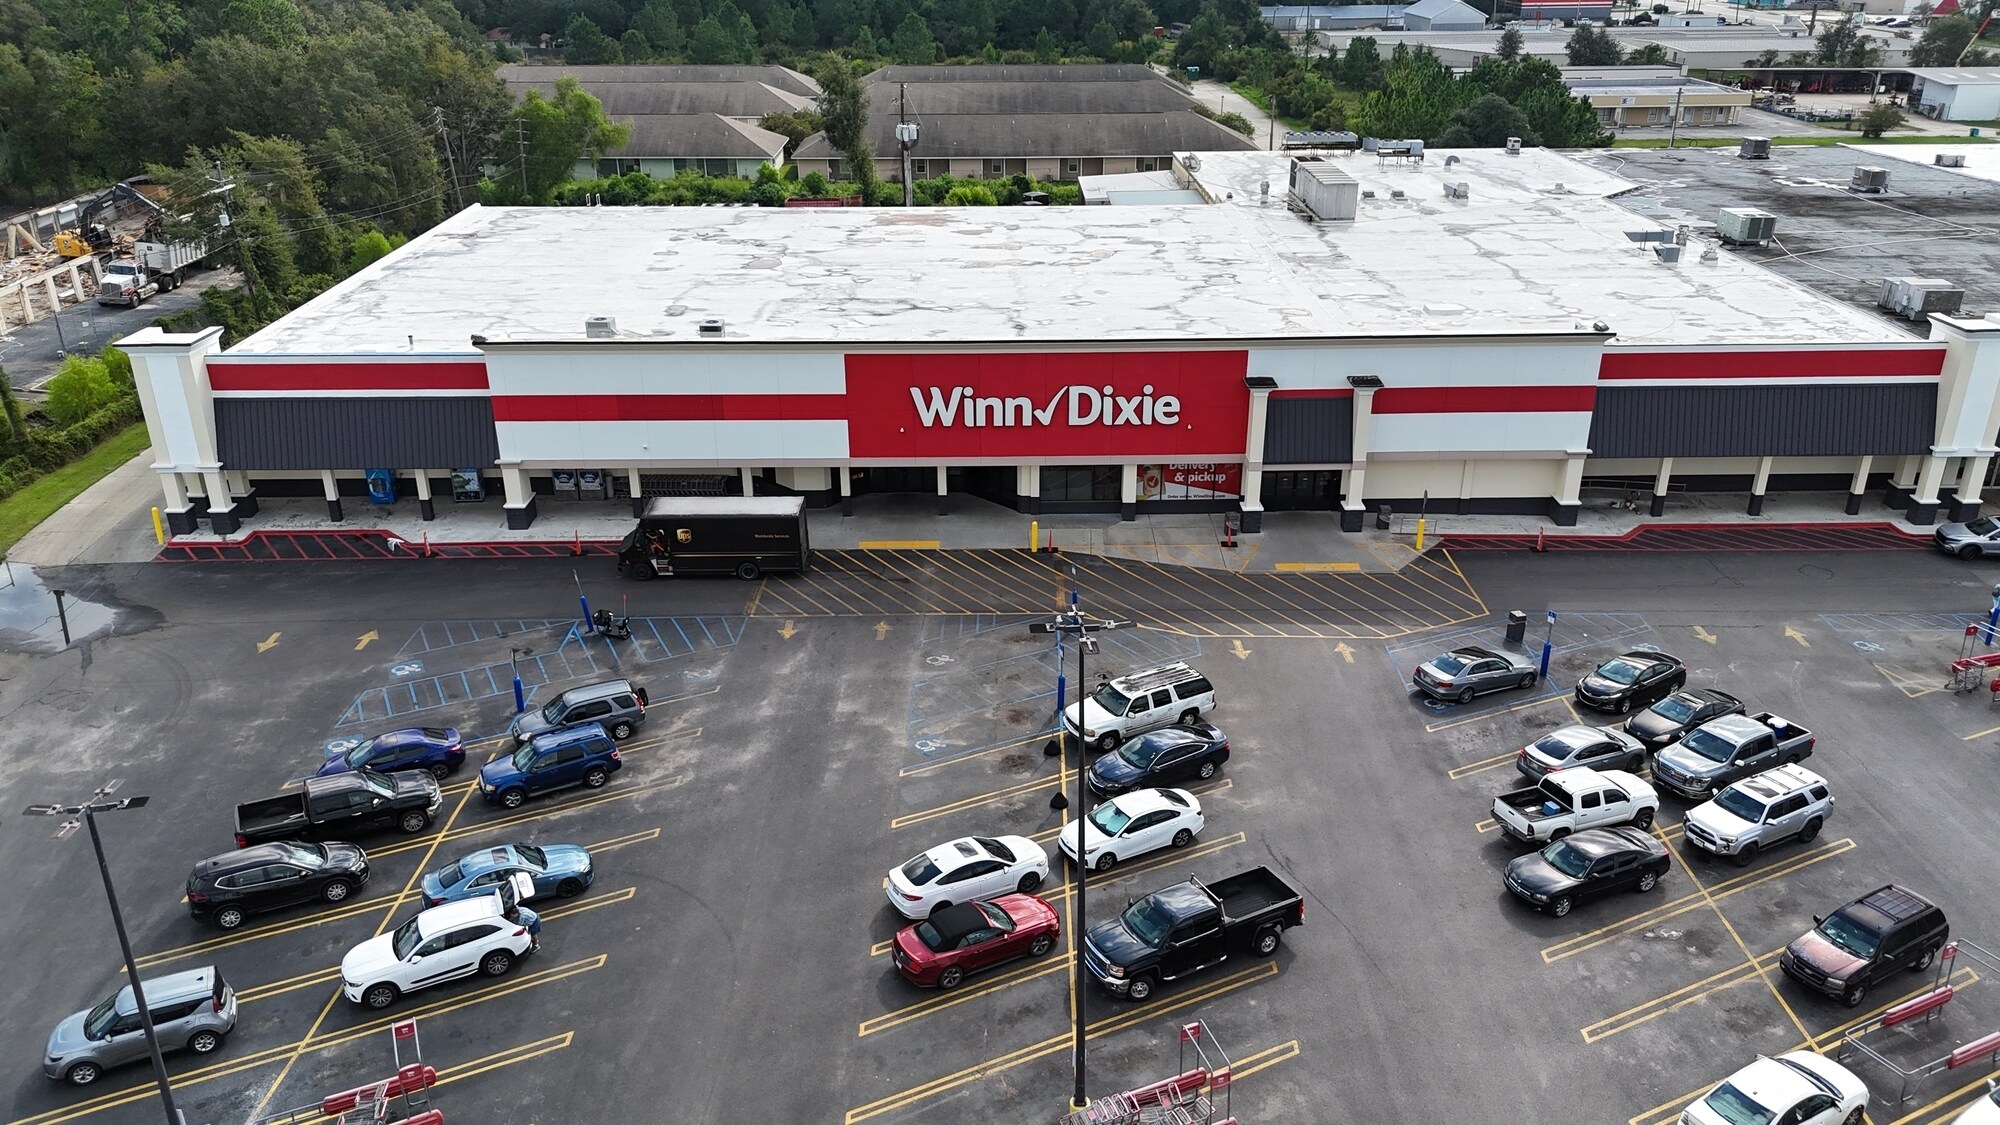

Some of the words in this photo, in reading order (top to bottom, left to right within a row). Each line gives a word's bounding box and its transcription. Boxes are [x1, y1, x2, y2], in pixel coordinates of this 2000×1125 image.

[909, 386, 1032, 427] Winn
[1068, 384, 1180, 426] Dixie
[1174, 472, 1184, 482] &
[1188, 471, 1226, 484] pickup
